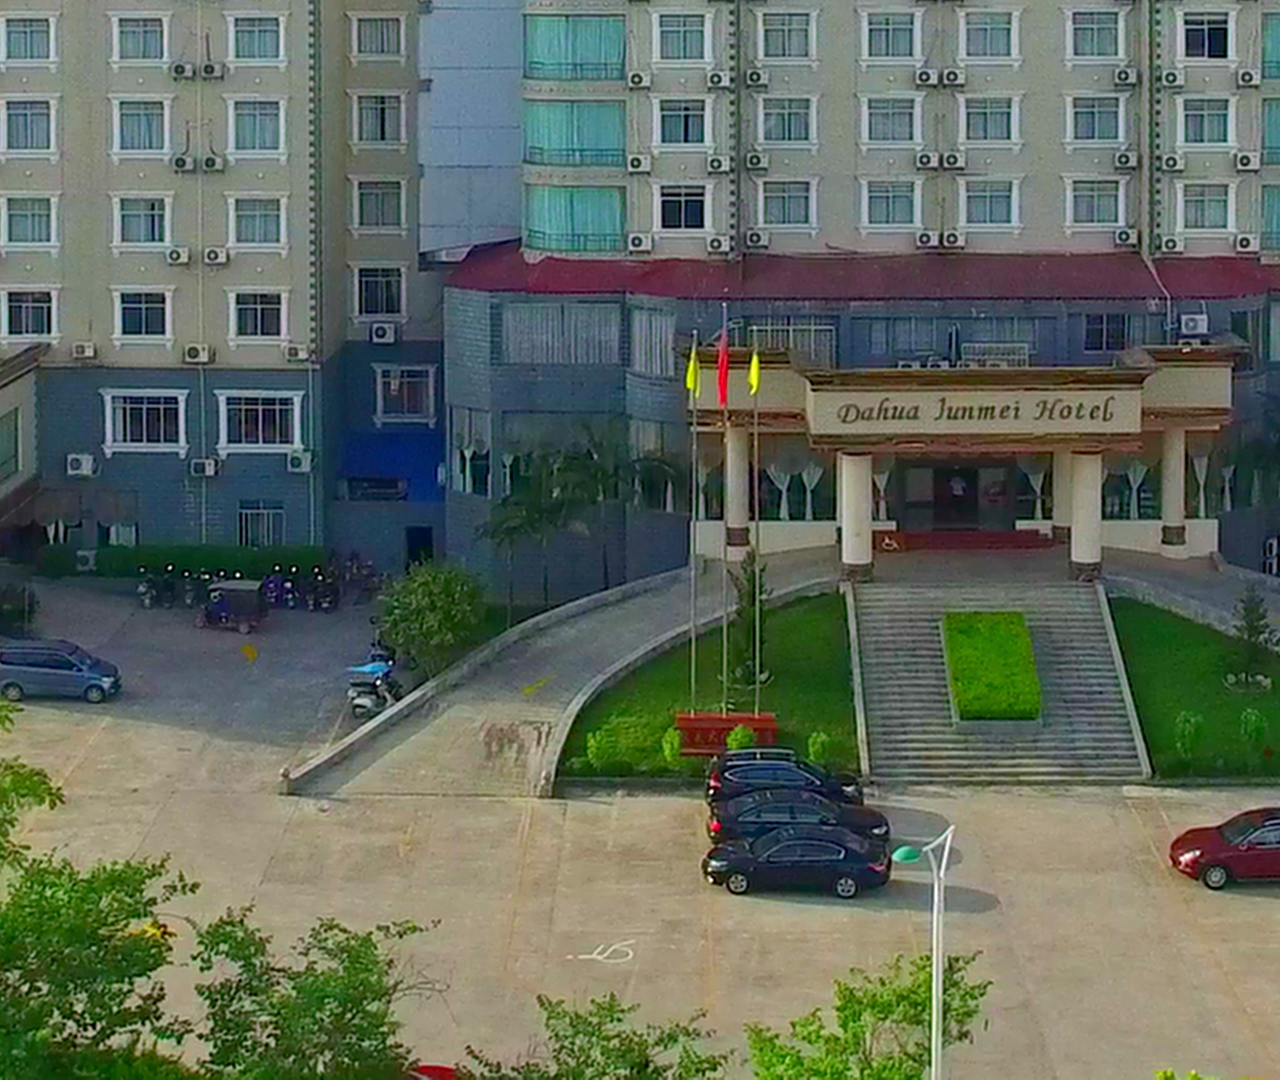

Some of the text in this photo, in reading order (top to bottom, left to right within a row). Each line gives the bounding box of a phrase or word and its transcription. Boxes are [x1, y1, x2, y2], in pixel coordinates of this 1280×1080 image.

[837, 396, 1116, 424] Dahua Junmei Hotel
